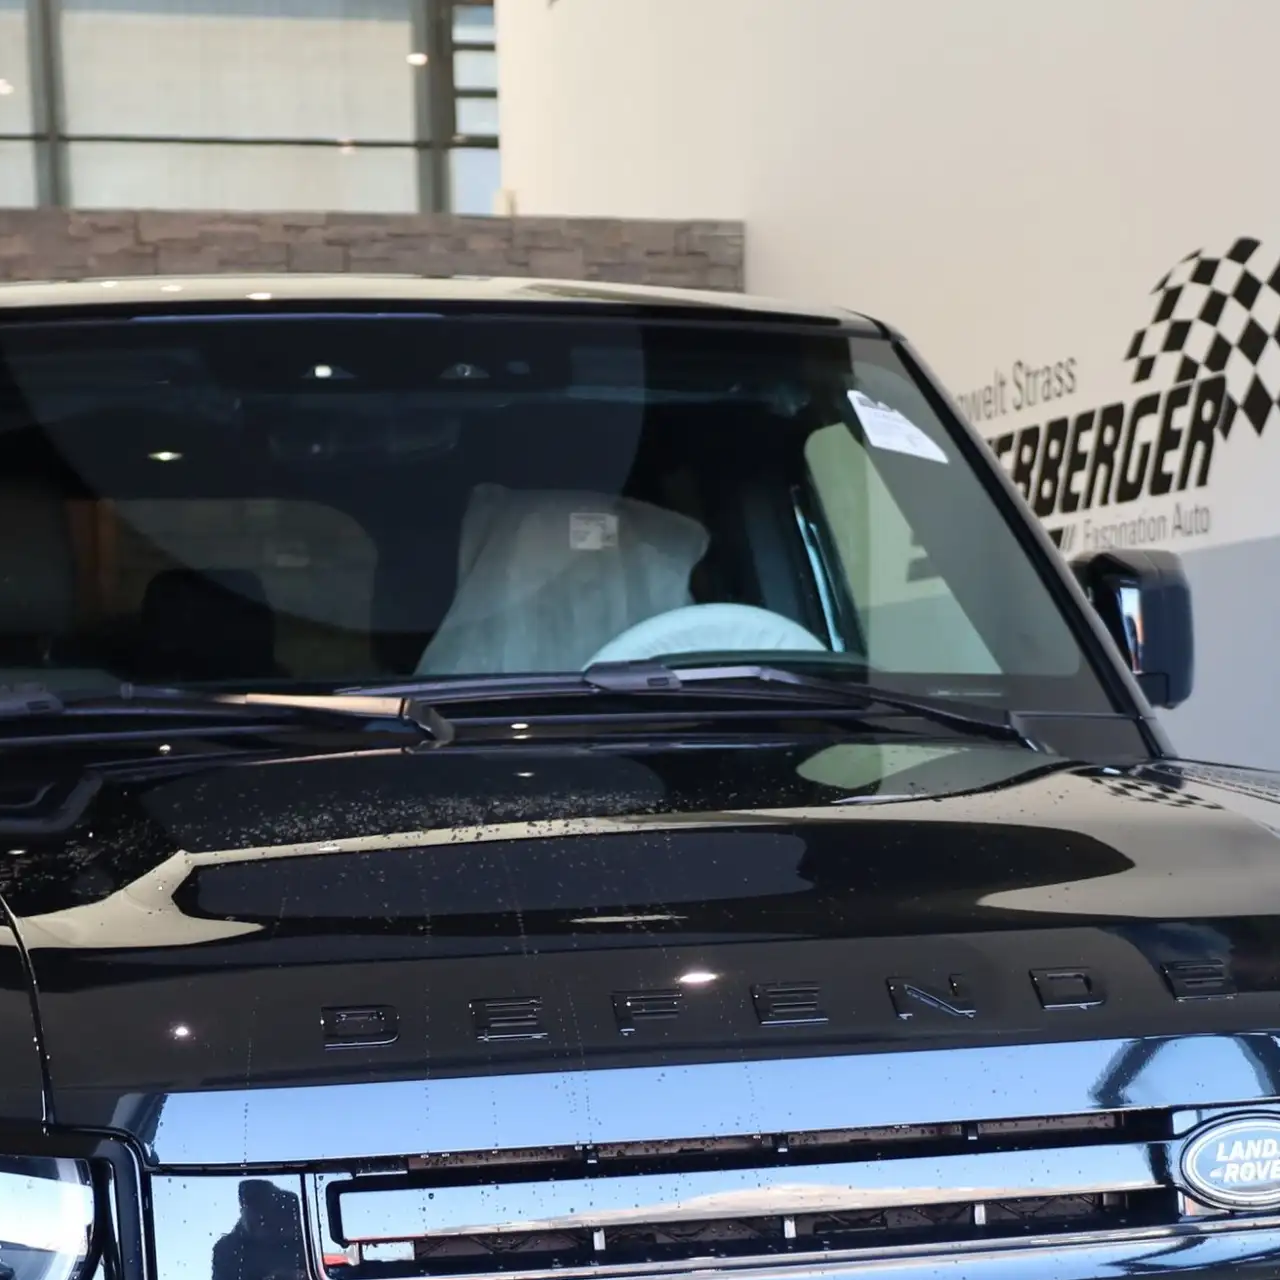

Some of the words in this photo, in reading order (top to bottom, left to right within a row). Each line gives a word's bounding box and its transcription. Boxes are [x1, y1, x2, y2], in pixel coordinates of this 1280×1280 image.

[957, 366, 1008, 421] welt
[1012, 357, 1077, 411] Strass
[986, 374, 1226, 517] RBERGER
[1084, 508, 1167, 549] Faszination
[1172, 501, 1210, 538] Auto
[1216, 1138, 1279, 1162] LAND
